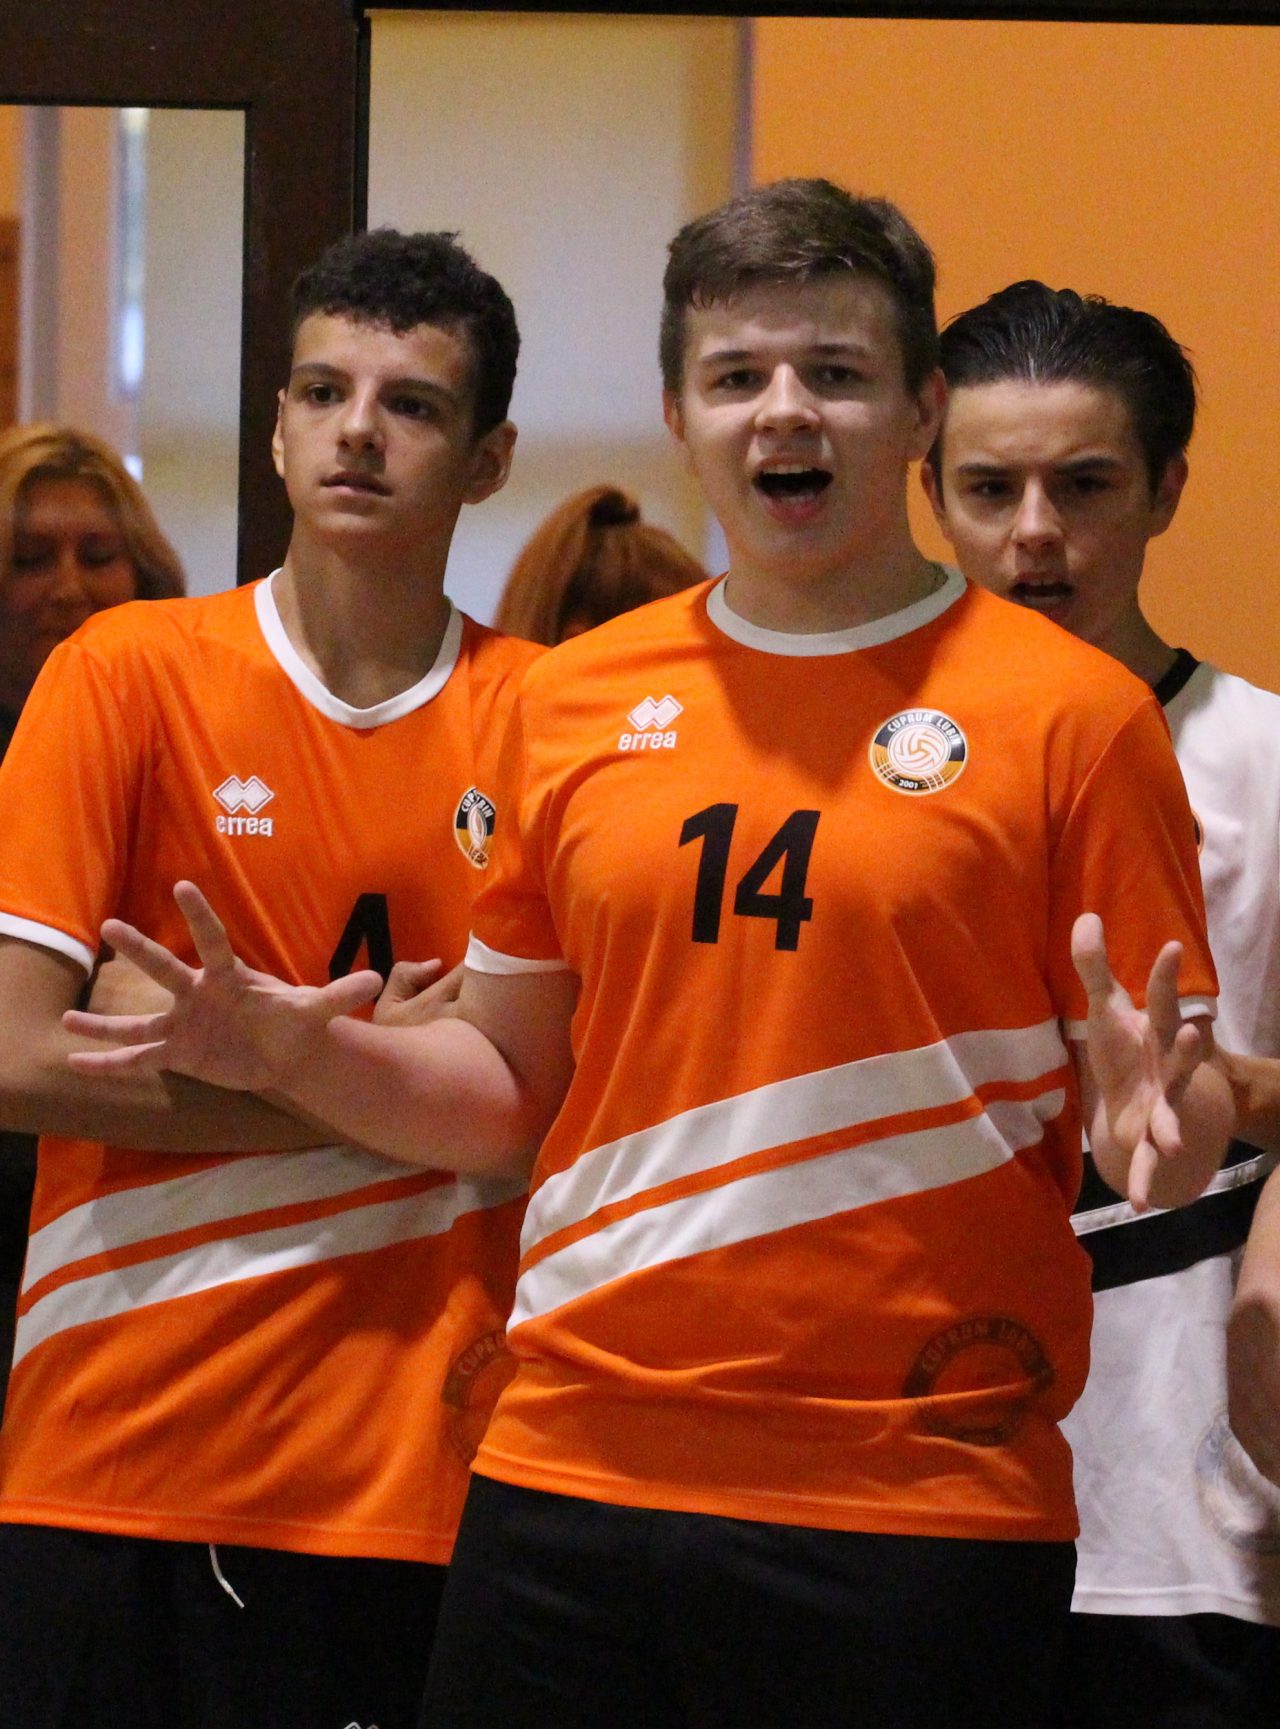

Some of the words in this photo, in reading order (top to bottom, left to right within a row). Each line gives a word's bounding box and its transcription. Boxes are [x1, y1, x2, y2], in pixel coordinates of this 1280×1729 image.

[887, 712, 934, 733] CUPRUM
[617, 730, 678, 751] errea
[898, 778, 920, 790] 2001
[214, 815, 273, 837] errea
[677, 802, 822, 952] 14
